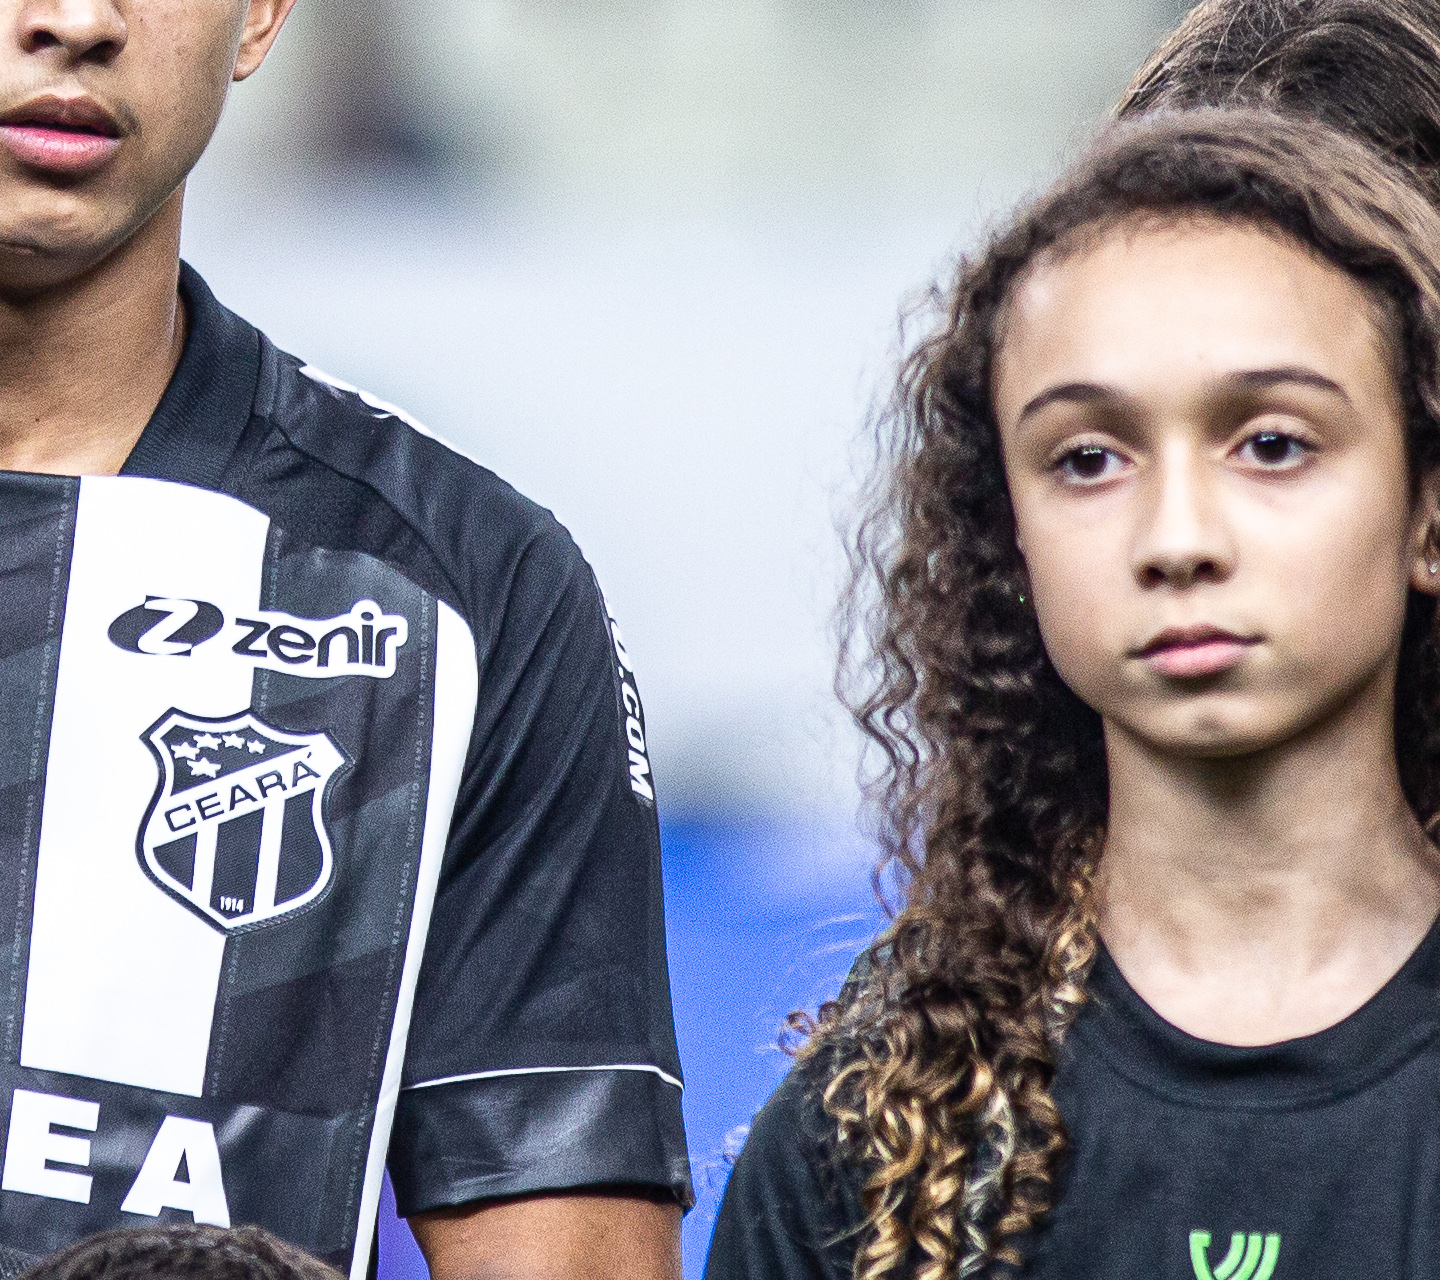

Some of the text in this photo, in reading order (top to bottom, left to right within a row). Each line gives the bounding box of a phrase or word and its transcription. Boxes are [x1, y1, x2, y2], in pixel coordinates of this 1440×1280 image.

[230, 610, 398, 668] zenir
[163, 751, 322, 833] CEARÁ
[219, 895, 245, 913] 1914
[120, 1114, 231, 1230] A
